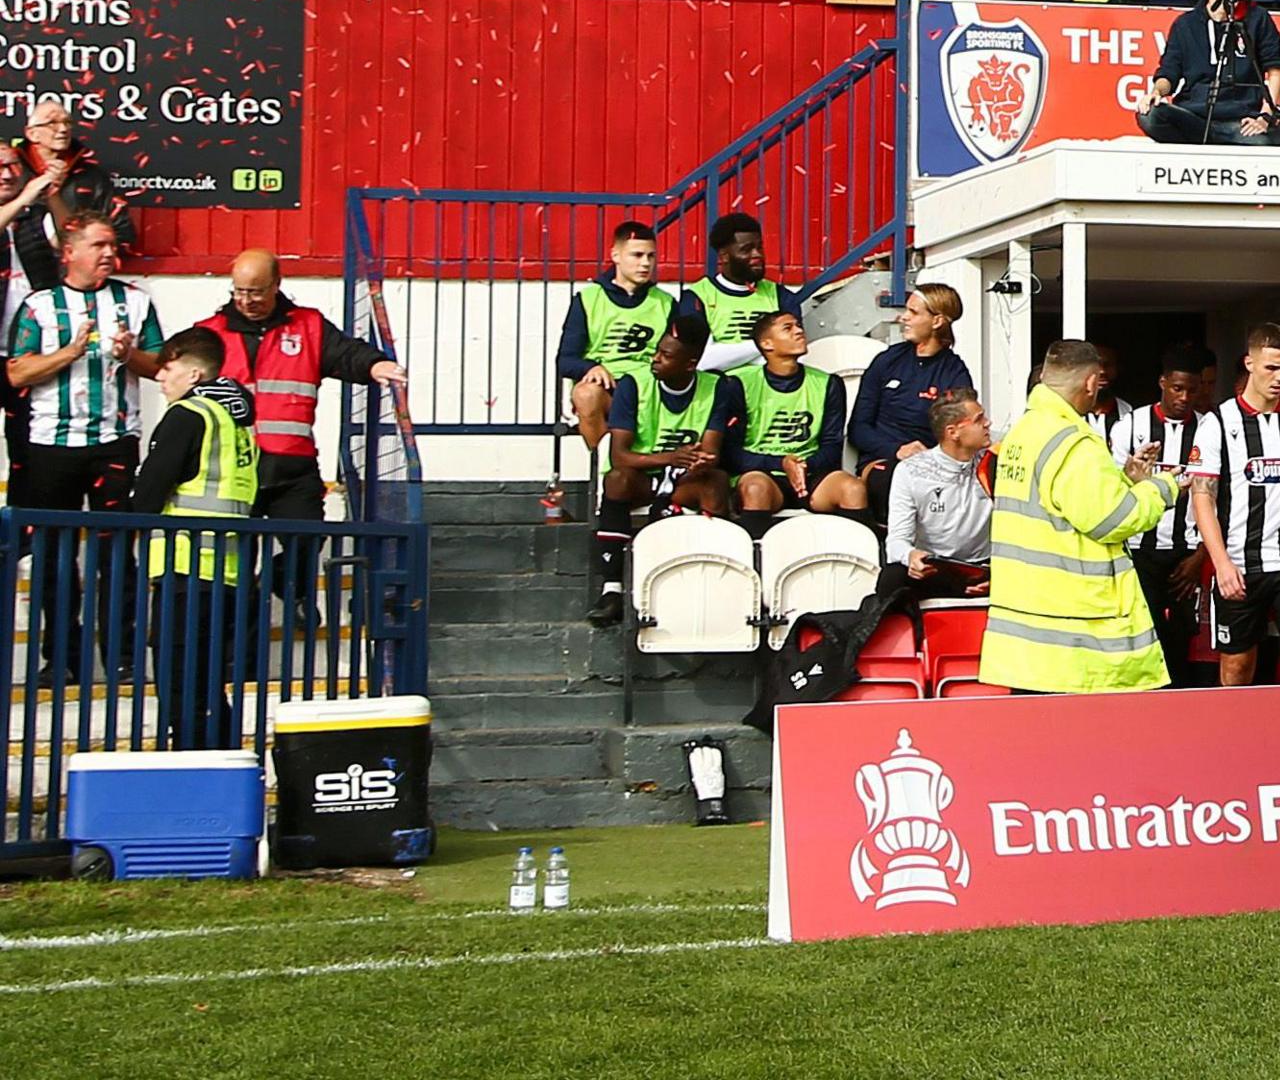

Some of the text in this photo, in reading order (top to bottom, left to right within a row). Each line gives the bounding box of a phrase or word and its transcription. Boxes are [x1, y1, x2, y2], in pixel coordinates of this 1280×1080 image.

[1063, 29, 1145, 66] THE
[117, 84, 148, 122] &
[159, 86, 282, 125] Gates
[1154, 167, 1248, 190] PLAYERS
[929, 501, 946, 514] GH
[987, 794, 1252, 857] Emirates
